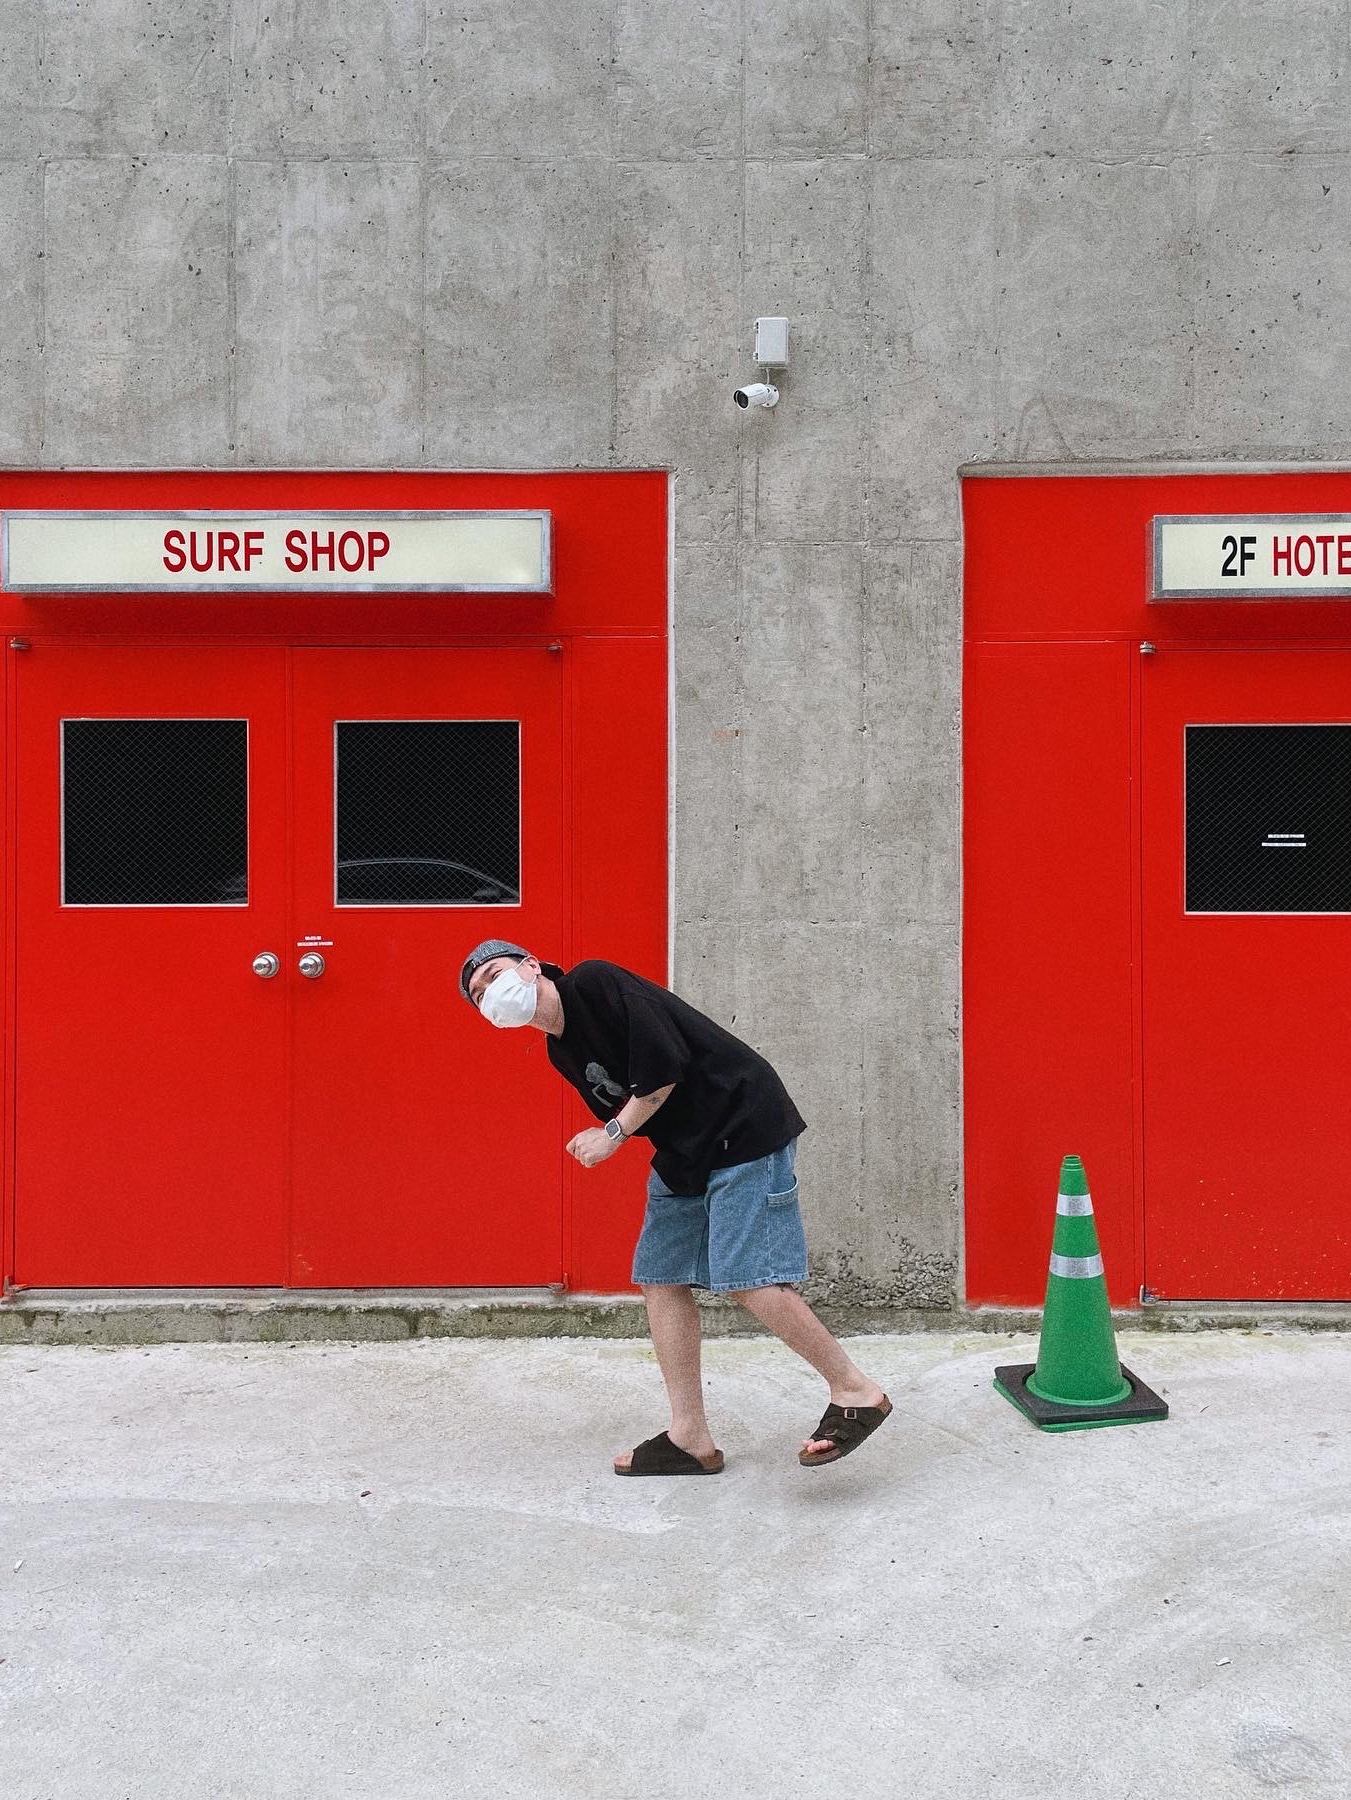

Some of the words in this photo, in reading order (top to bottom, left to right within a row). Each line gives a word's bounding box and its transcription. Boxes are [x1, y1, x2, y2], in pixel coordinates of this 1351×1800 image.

[163, 530, 265, 573] SURF
[285, 530, 390, 573] SHOP
[1221, 535, 1257, 577] 2F
